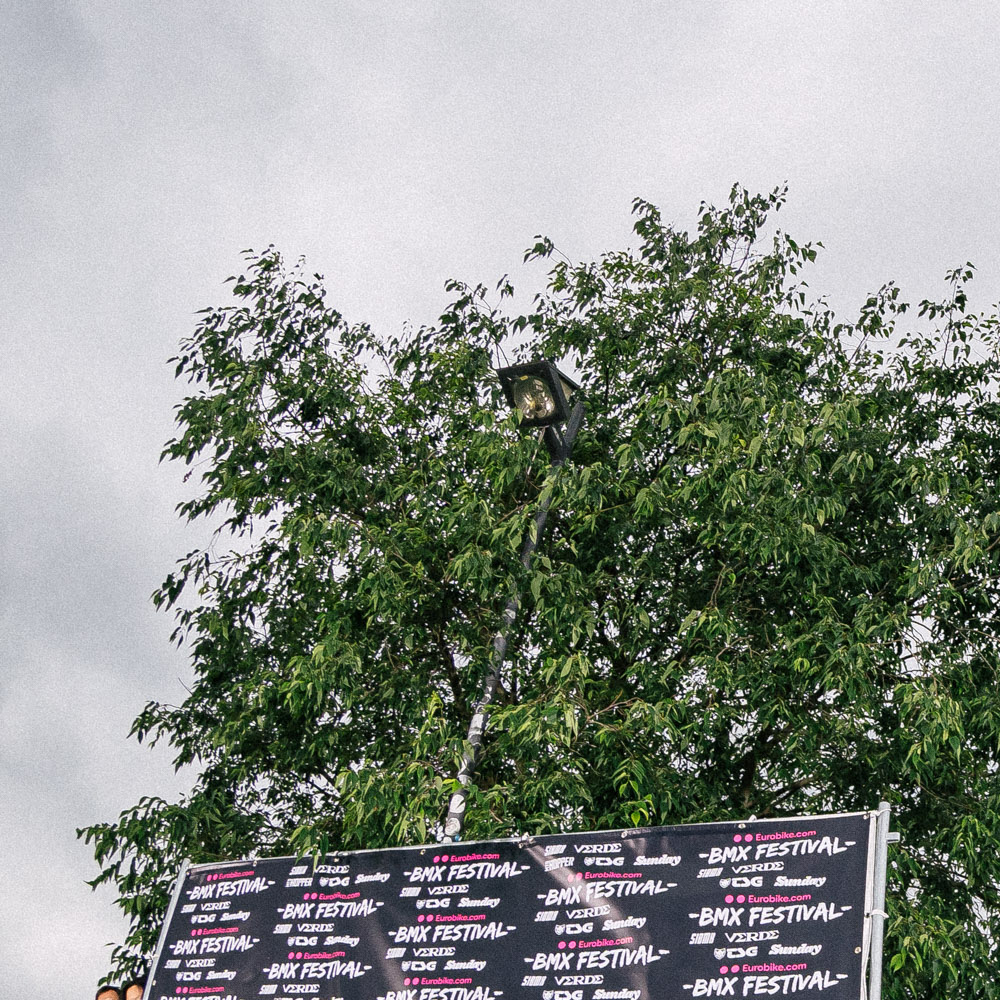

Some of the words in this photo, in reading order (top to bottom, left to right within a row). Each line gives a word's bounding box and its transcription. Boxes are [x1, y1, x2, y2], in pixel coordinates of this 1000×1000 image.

[756, 831, 816, 841] Eurobike.com
[450, 853, 500, 862] Eurobike.com
[633, 854, 681, 866] Sunday
[774, 876, 826, 887] Sunday
[458, 897, 500, 908] Sunday
[748, 894, 811, 903] Eurobike.com
[436, 914, 486, 922] Eurobike.com
[602, 916, 646, 930] Sunday
[578, 939, 632, 948] Eurobike.com
[768, 943, 822, 955] Sunday
[444, 959, 486, 971] Sunday
[742, 963, 807, 972] Eurobike.com
[592, 988, 641, 1000] Sunday
